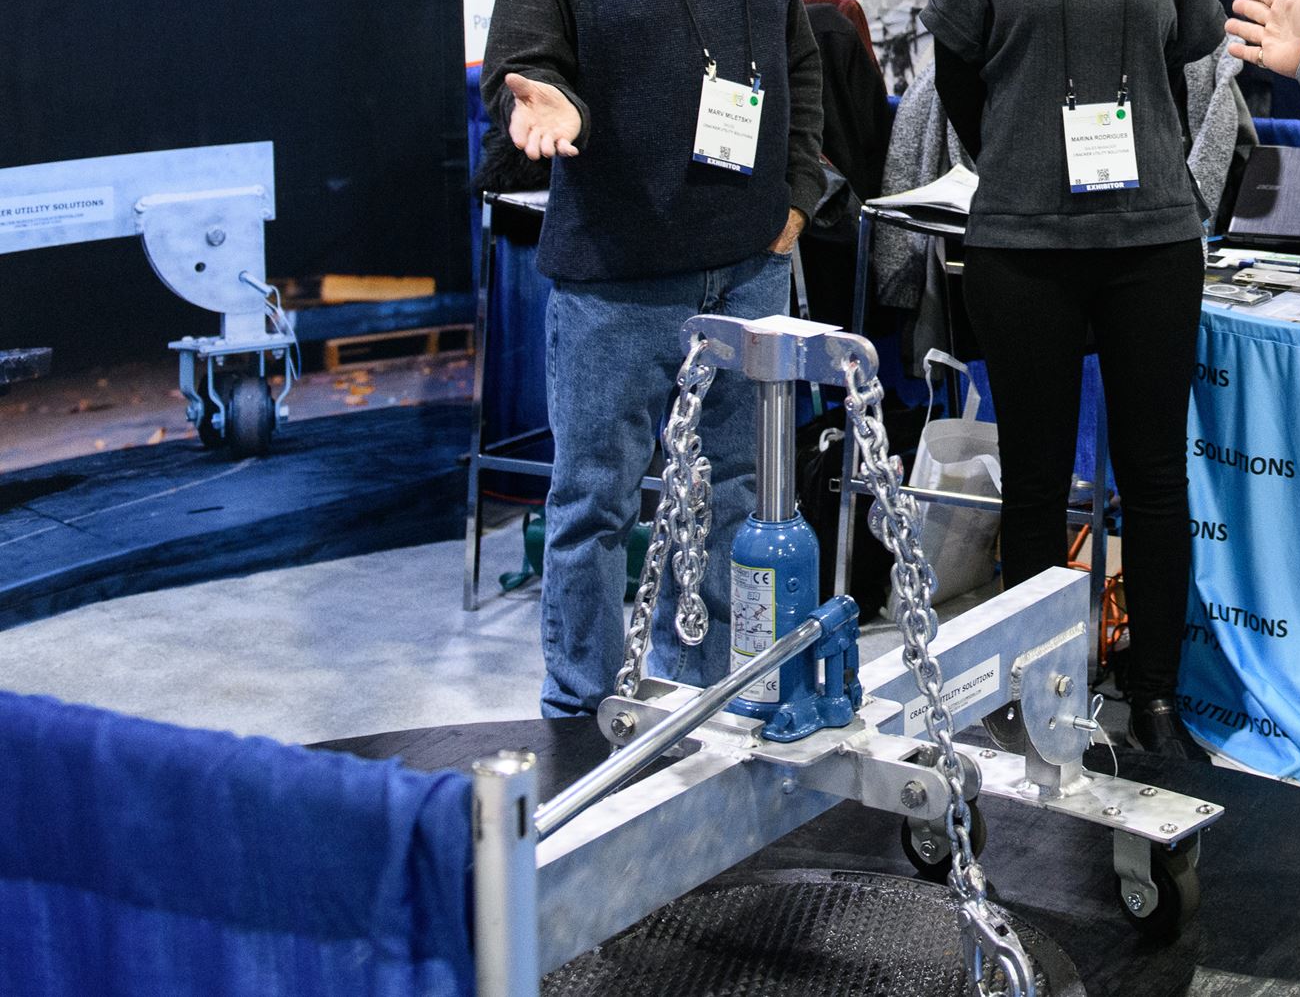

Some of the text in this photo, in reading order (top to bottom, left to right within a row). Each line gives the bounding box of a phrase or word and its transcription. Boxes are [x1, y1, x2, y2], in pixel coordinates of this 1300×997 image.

[1086, 181, 1125, 191] EXHIBITOR
[14, 204, 50, 215] UTILITY
[53, 199, 104, 211] SOLUTIONS
[1193, 438, 1295, 479] SOLUTIONS
[909, 704, 930, 720] CRACK
[941, 687, 962, 703] TILITY
[961, 669, 995, 693] SOLUTIONS
